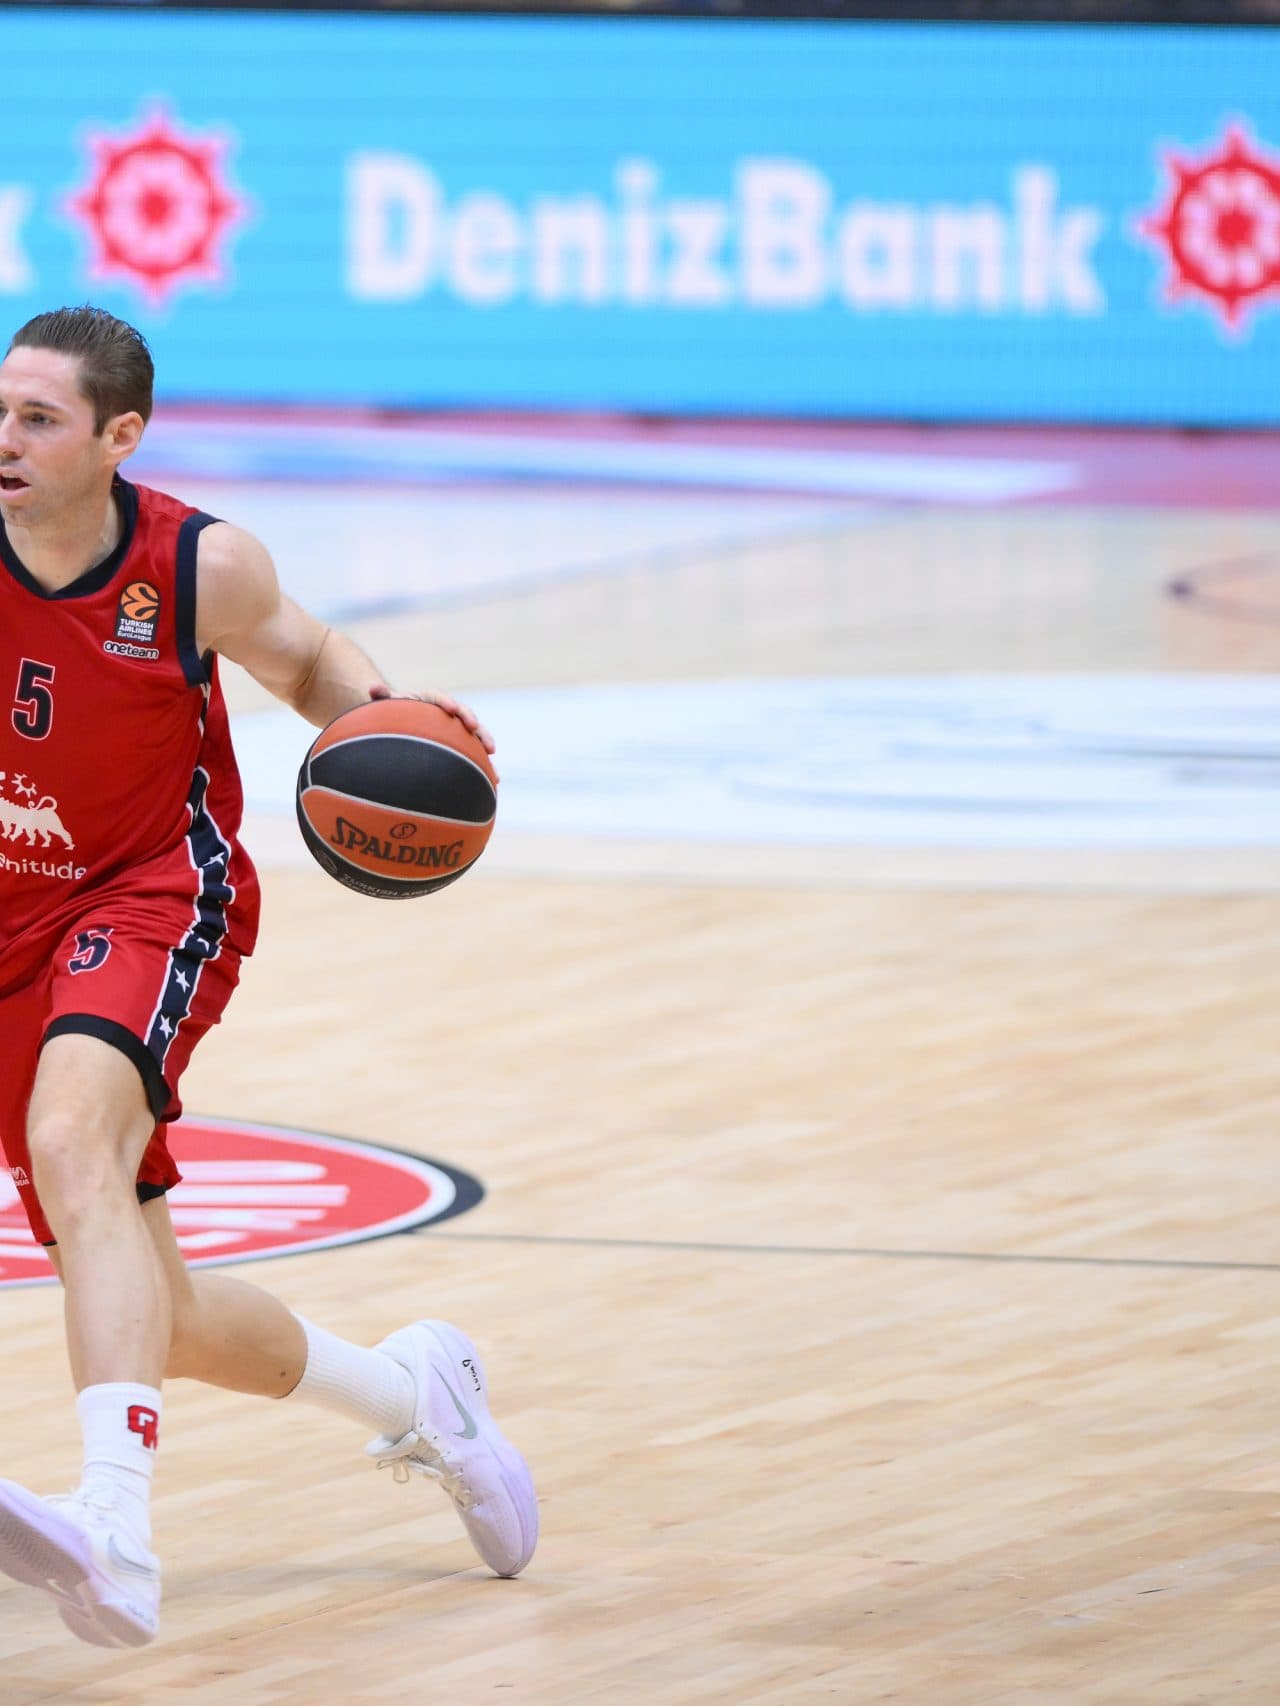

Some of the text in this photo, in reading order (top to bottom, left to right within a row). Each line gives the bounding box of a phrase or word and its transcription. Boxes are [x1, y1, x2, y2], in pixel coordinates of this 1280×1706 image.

[347, 151, 1104, 317] DenizBank
[118, 625, 153, 636] AIRLINES
[120, 618, 154, 630] TURKISH
[104, 641, 159, 659] oneteam
[11, 657, 55, 741] 5
[330, 816, 464, 869] SPALDING
[68, 927, 114, 976] 5
